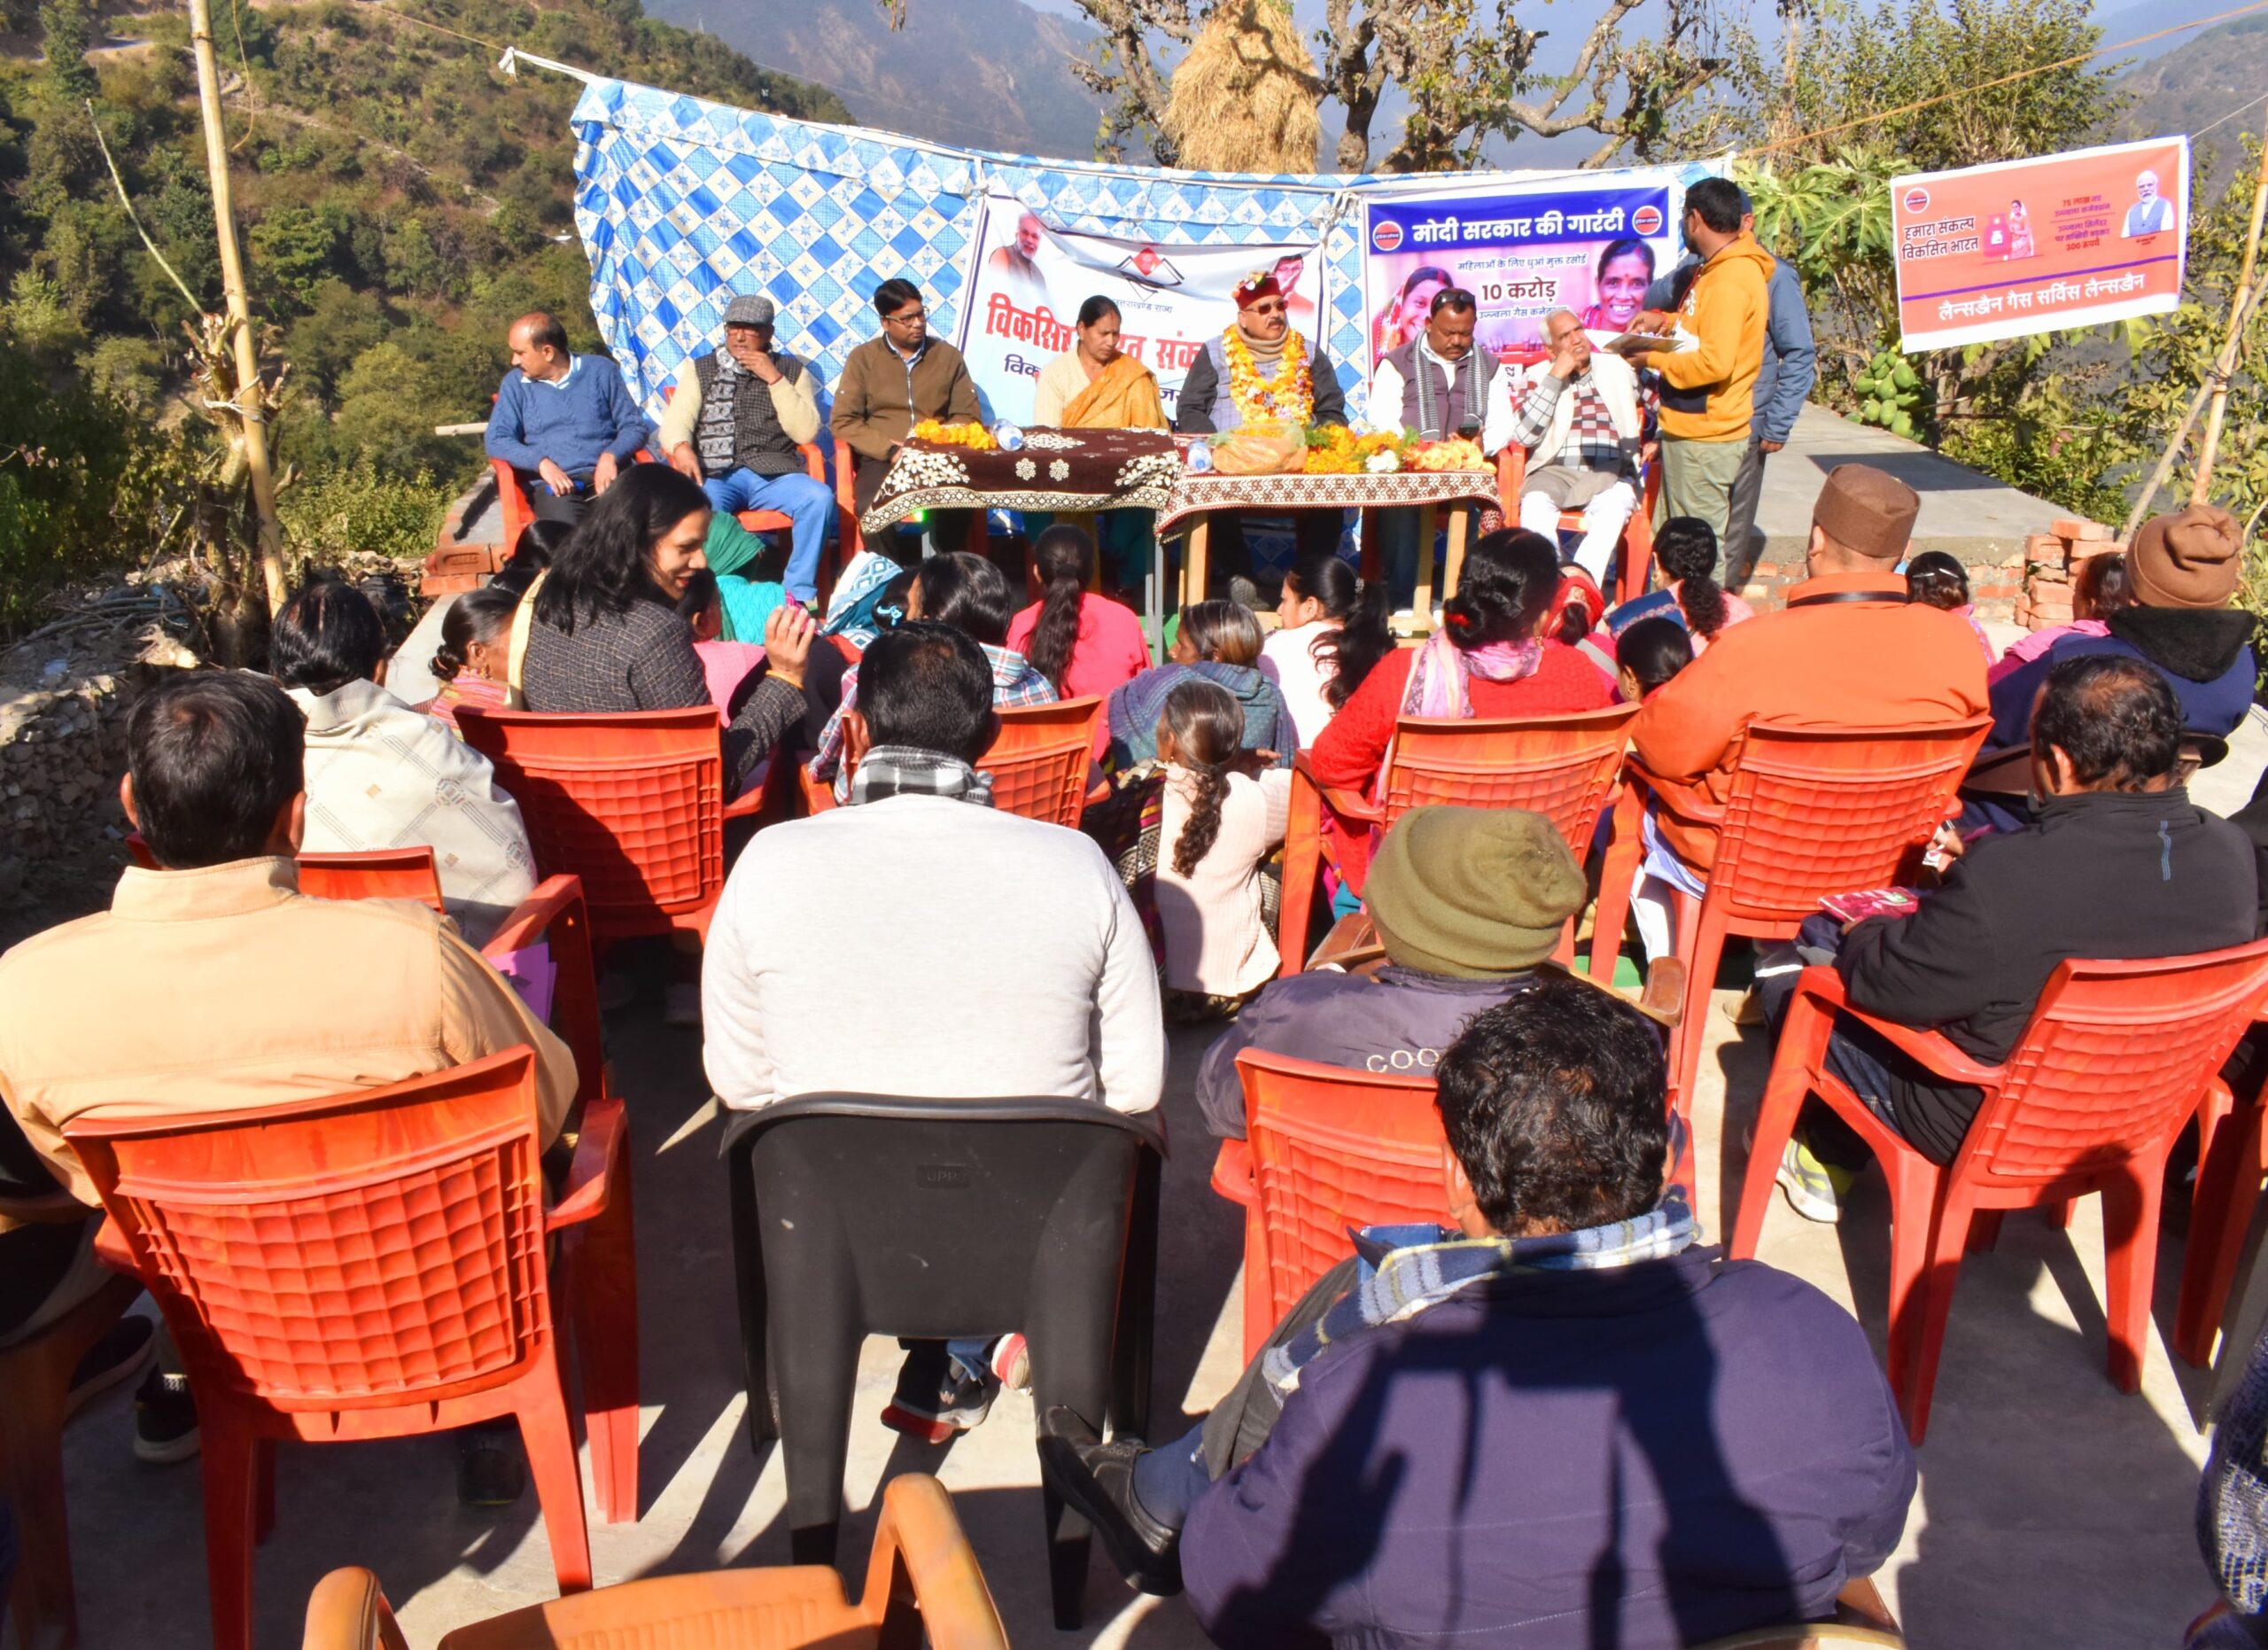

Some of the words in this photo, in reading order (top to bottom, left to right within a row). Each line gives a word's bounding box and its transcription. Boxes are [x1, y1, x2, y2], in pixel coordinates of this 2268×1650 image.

[1411, 216, 1459, 242] मोदी
[1462, 218, 1532, 240] सरकार
[1534, 210, 1564, 236] की
[1566, 206, 1625, 233] गारंटी
[1904, 223, 1936, 240] हमारा
[1938, 217, 1974, 234] संकल्प
[1902, 239, 1948, 260] विकसित
[1951, 237, 1978, 252] भारत
[1458, 258, 1495, 270] महिलाओं
[1497, 259, 1505, 269] के
[1508, 257, 1525, 268] लिए
[1482, 284, 1502, 300] 10
[1507, 276, 1557, 302] करोड़
[2007, 290, 2032, 309] गैस
[2036, 281, 2081, 305] सर्विस
[1154, 304, 1173, 313] राज्य
[1513, 307, 1527, 316] गैस
[1366, 1048, 1441, 1073] COO
